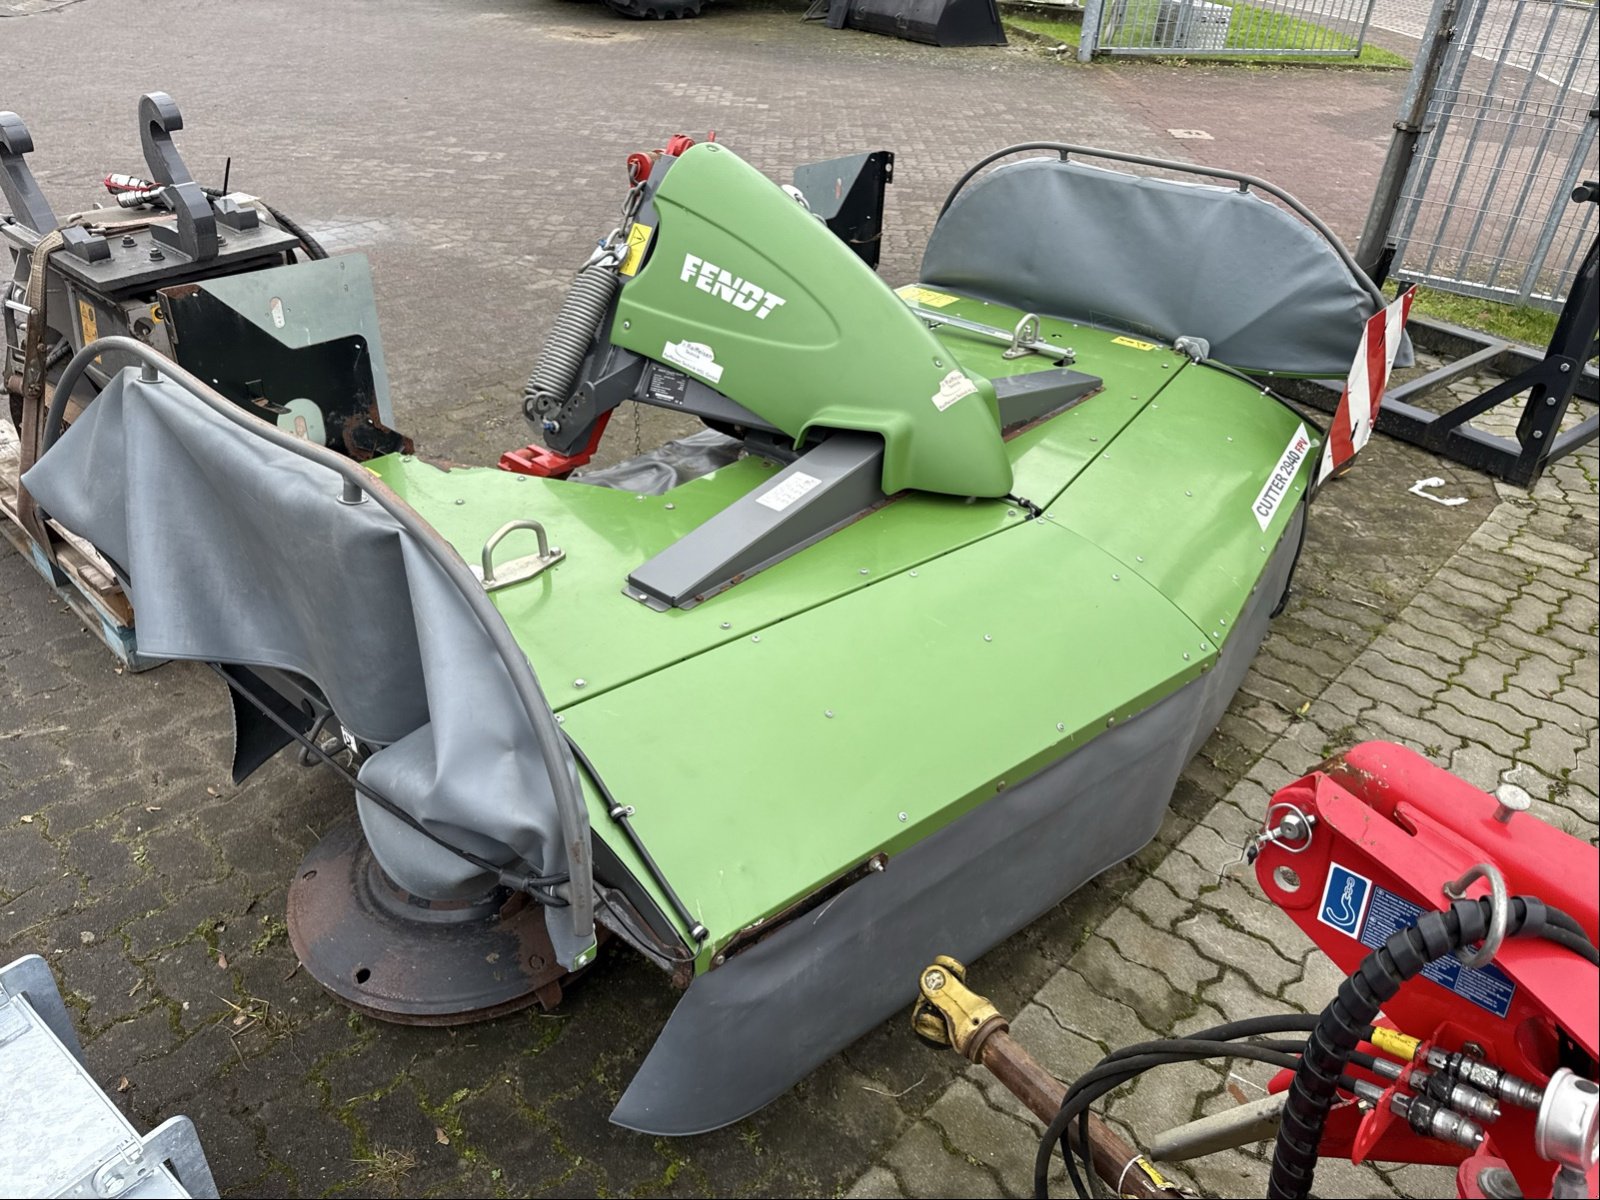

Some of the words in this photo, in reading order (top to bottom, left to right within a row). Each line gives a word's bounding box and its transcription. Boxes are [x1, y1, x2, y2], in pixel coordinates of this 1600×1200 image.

[680, 253, 787, 320] FENDT
[1256, 473, 1289, 517] CUTTER
[1280, 450, 1301, 476] 2940
[1294, 437, 1309, 455] FPV
